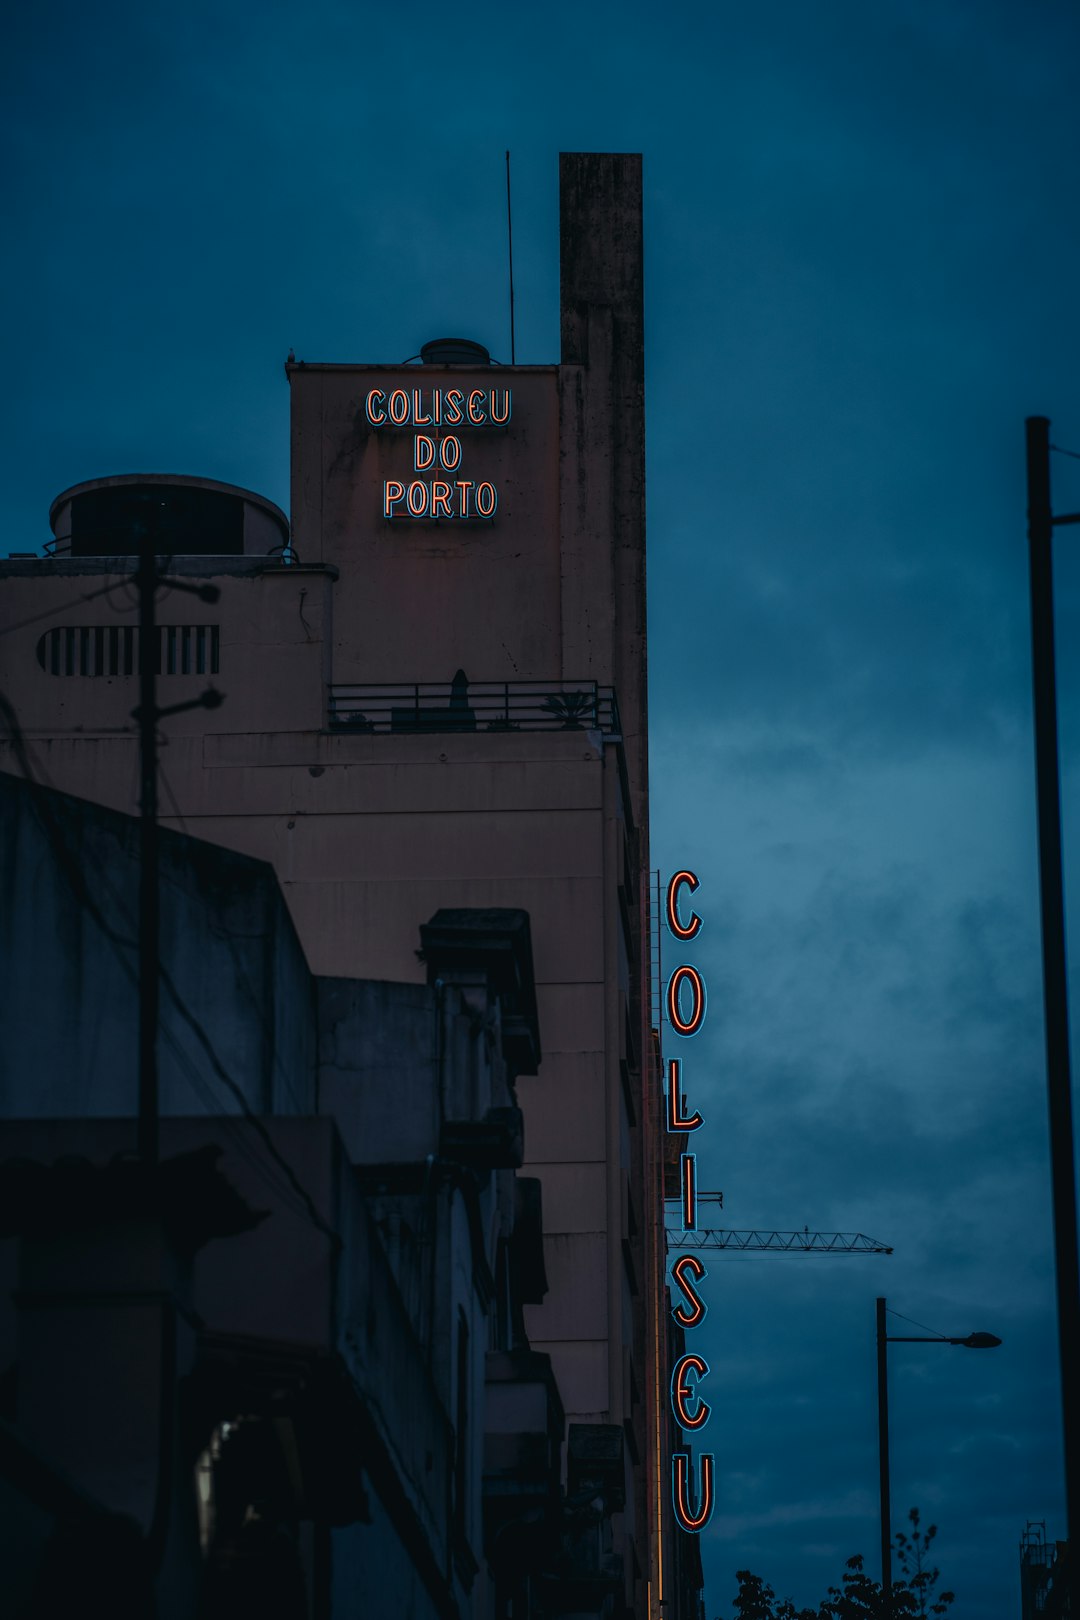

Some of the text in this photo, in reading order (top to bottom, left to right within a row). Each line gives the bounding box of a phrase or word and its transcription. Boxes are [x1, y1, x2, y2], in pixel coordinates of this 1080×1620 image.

[366, 388, 512, 426] COLISEU
[414, 434, 462, 472] DO
[384, 480, 498, 519] PORTO
[665, 870, 715, 1533] COLISEU
